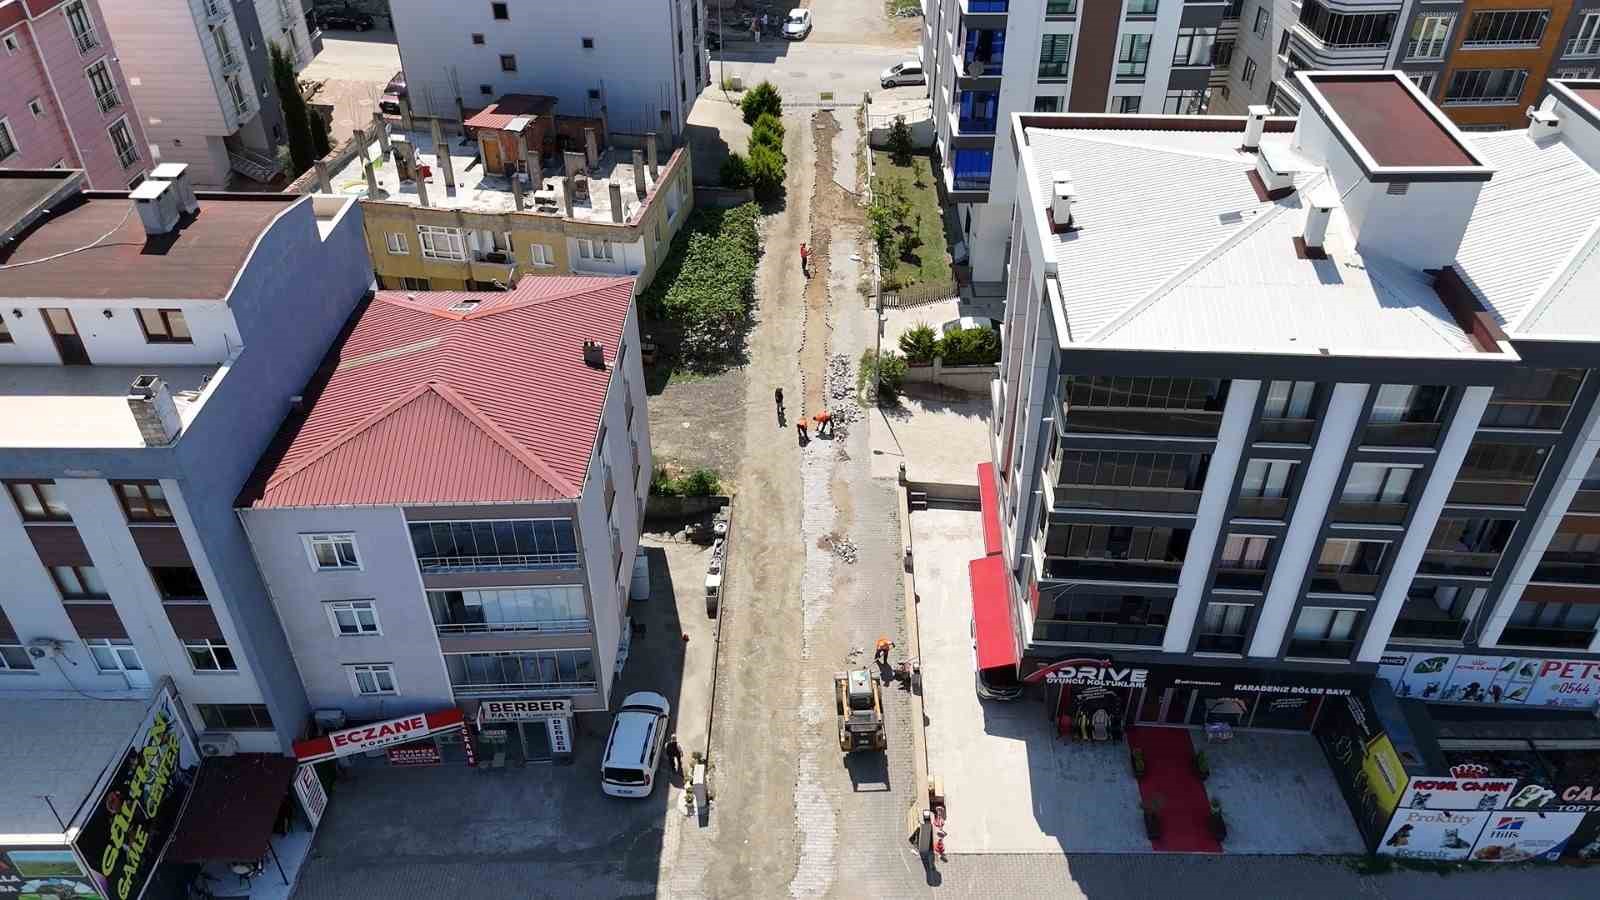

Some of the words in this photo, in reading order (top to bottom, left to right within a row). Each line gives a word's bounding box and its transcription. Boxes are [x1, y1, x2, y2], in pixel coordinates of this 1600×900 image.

[1559, 682, 1590, 695] 0544
[489, 701, 564, 712] BERBER
[334, 717, 424, 747] ECZANE
[118, 824, 149, 900] GAME
